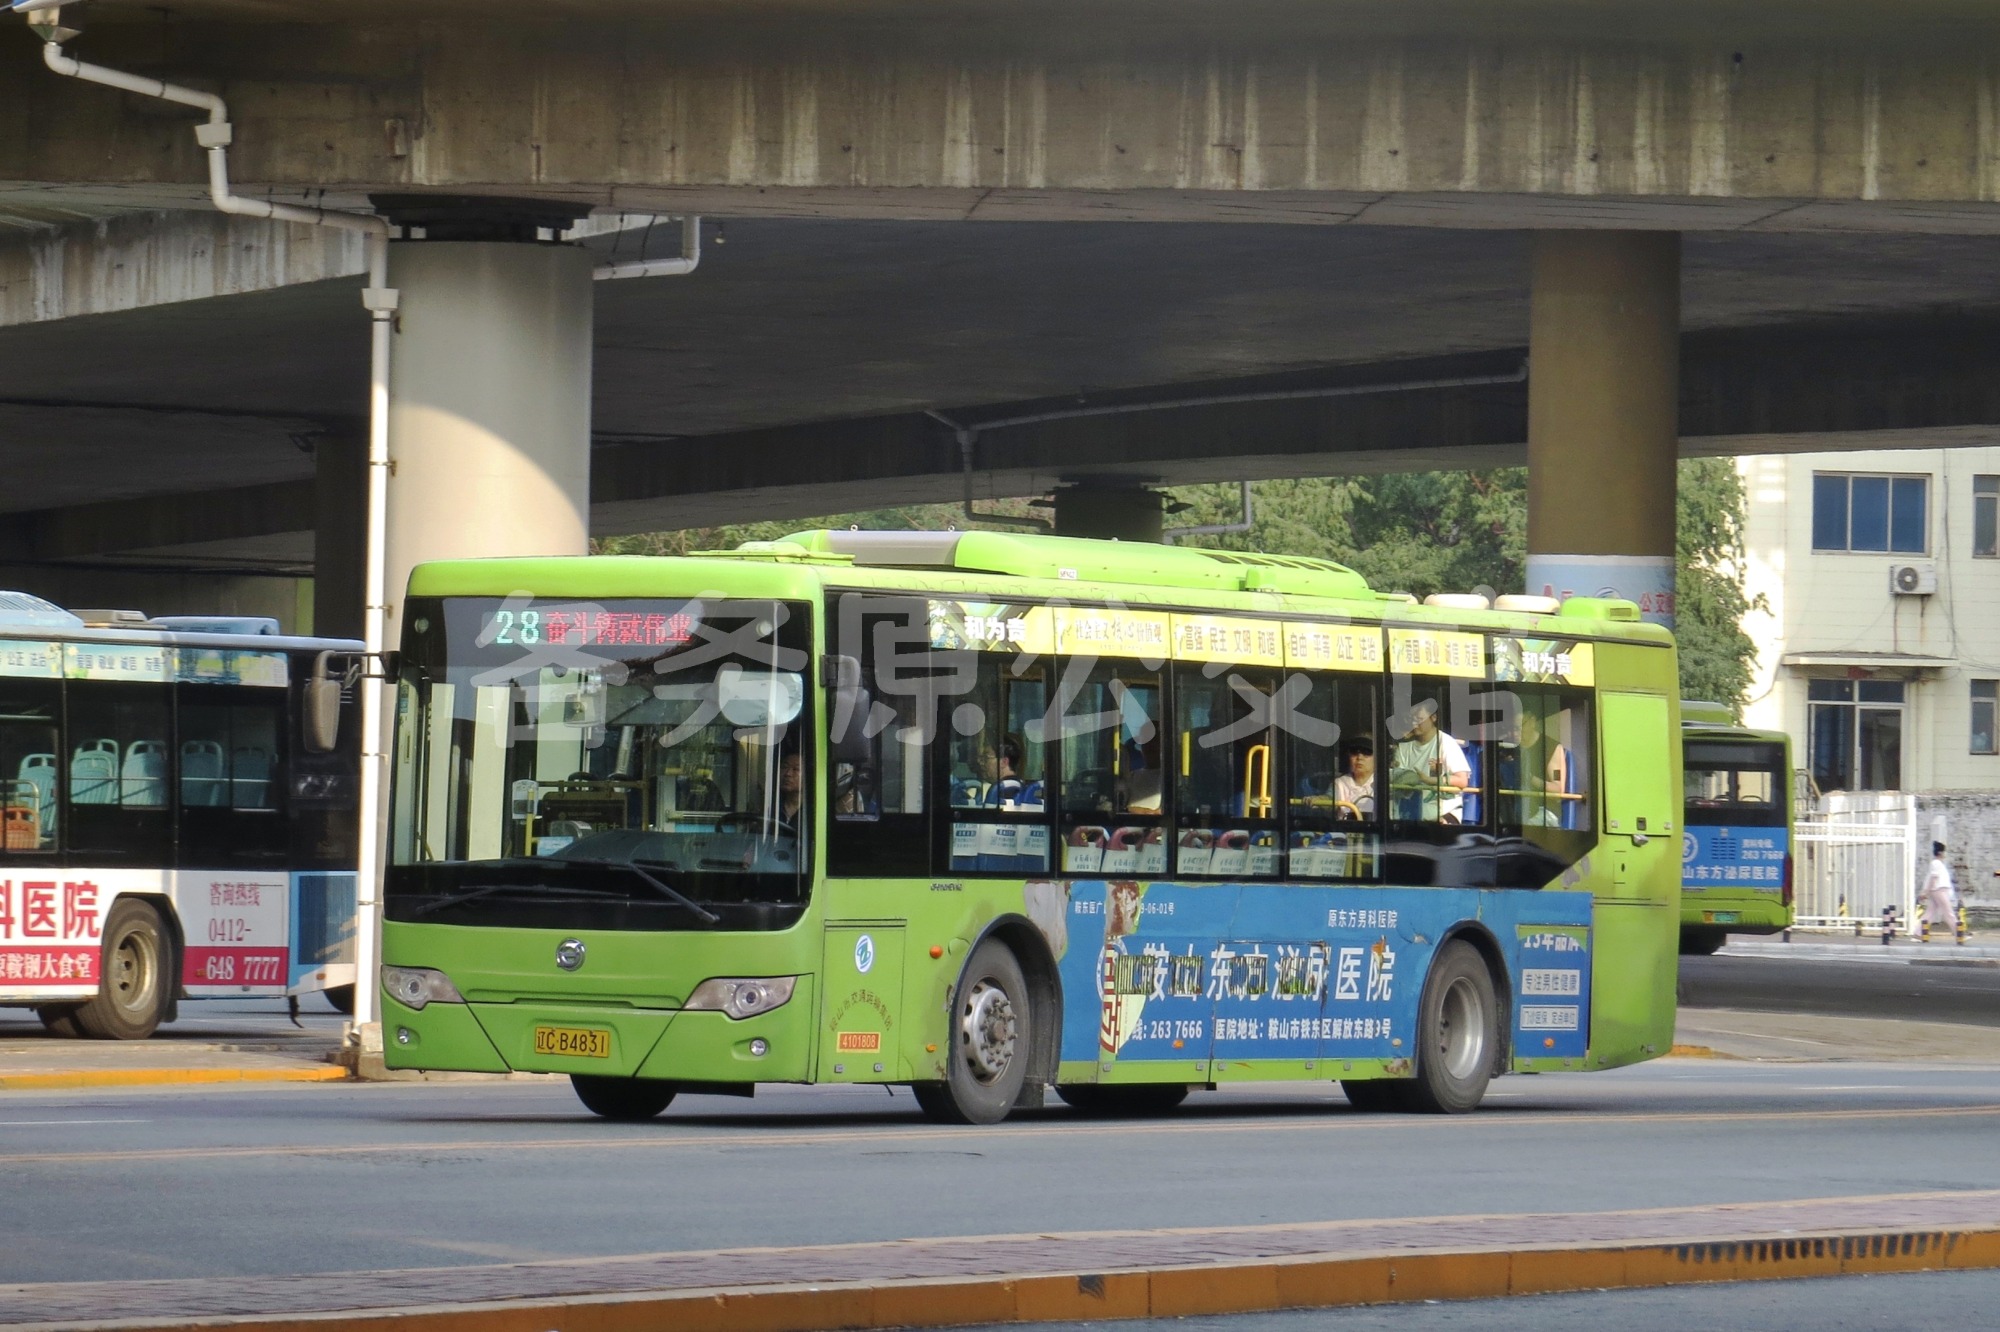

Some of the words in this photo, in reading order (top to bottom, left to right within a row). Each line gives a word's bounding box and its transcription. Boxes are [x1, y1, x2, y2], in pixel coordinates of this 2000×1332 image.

[496, 610, 540, 644] 28
[545, 611, 692, 645] 奋斗铸就伟业
[964, 615, 1026, 642] 和为贵
[1209, 627, 1228, 652] 民主
[1290, 634, 1308, 658] 自由
[1337, 635, 1354, 661] 公正
[1521, 651, 1571, 676] 和为贵
[1328, 909, 1398, 929] 原东方男科医院
[206, 956, 235, 981] 648
[243, 956, 280, 981] 7777
[842, 1034, 877, 1049] 4101808
[1150, 1020, 1172, 1039] 263
[1175, 1020, 1203, 1039] 7666
